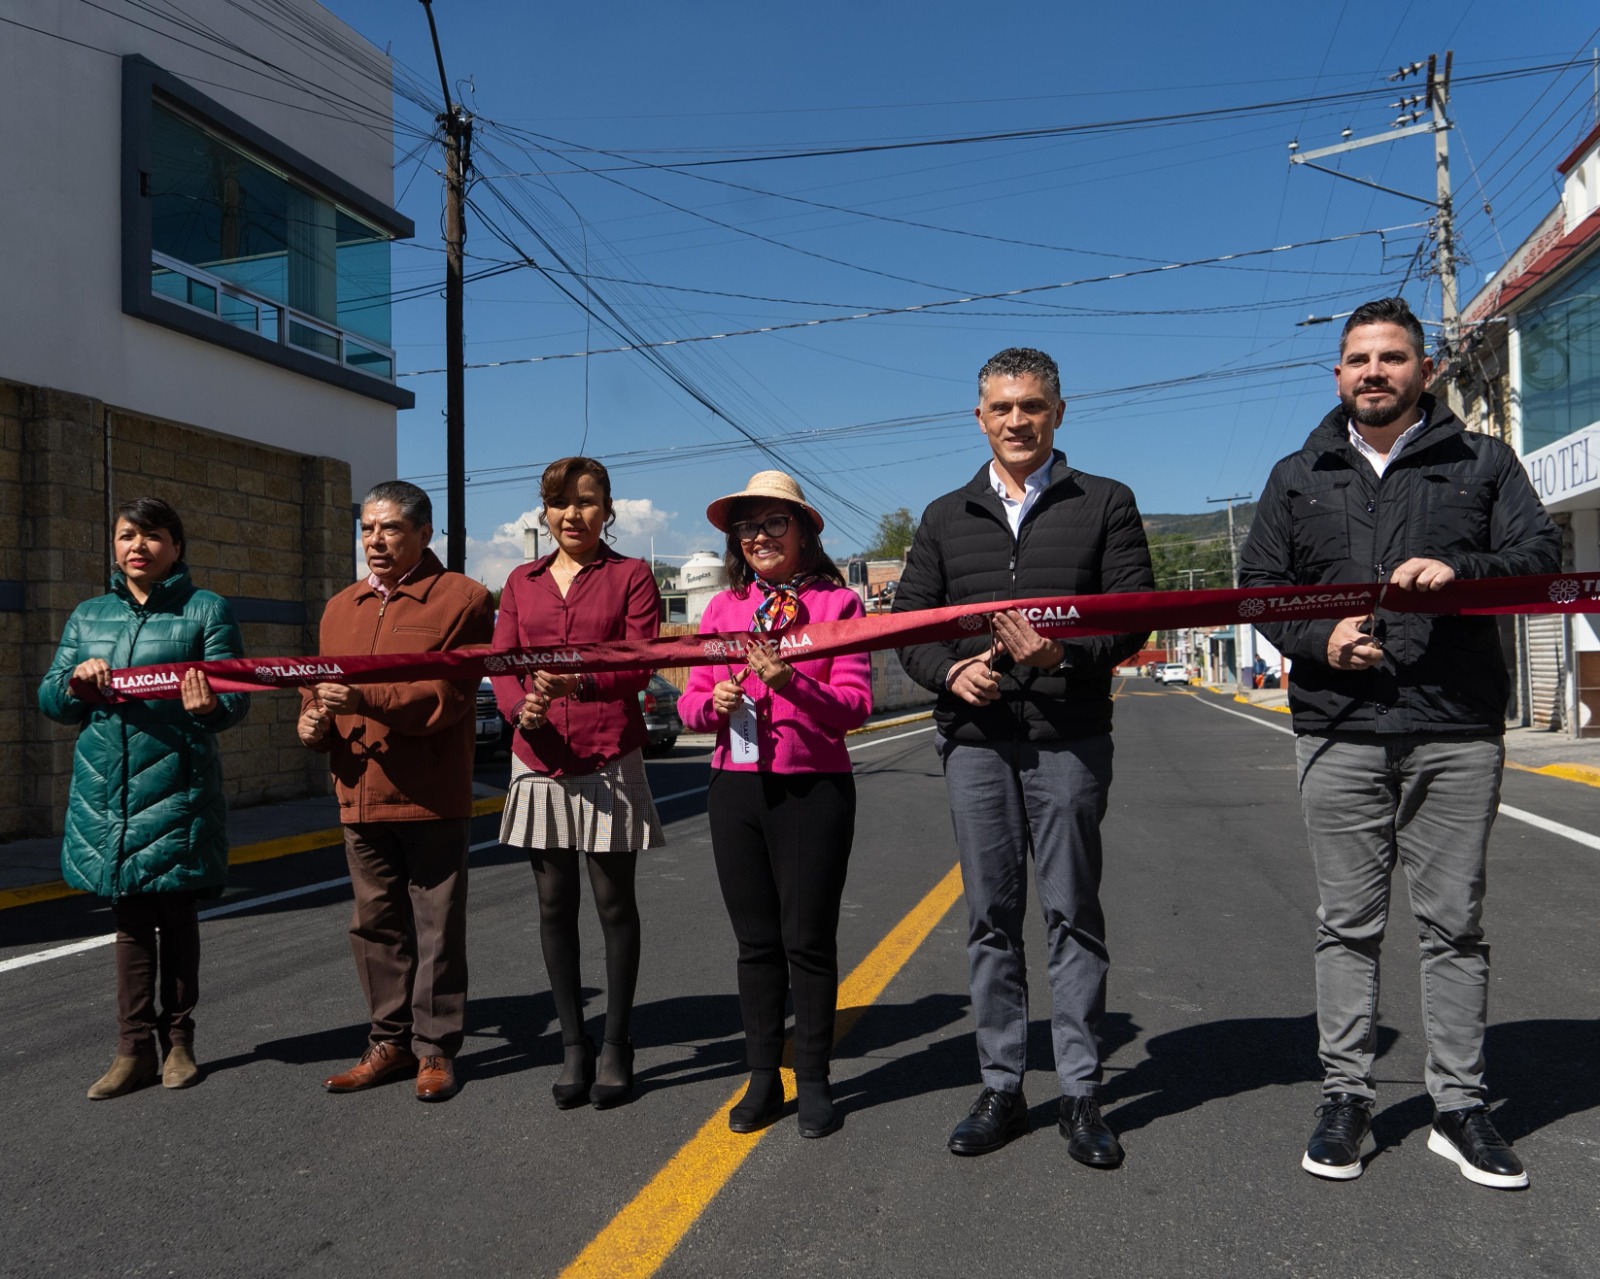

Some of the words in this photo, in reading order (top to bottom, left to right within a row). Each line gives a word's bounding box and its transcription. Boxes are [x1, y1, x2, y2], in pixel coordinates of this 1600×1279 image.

[1531, 436, 1598, 499] HOTEL
[1268, 591, 1372, 608] TLAXCALA
[1324, 600, 1366, 608] HISTORIA
[503, 651, 584, 666] TLAXCALA
[272, 662, 344, 677] TLAXCALA
[112, 671, 180, 689] TLAXCALA
